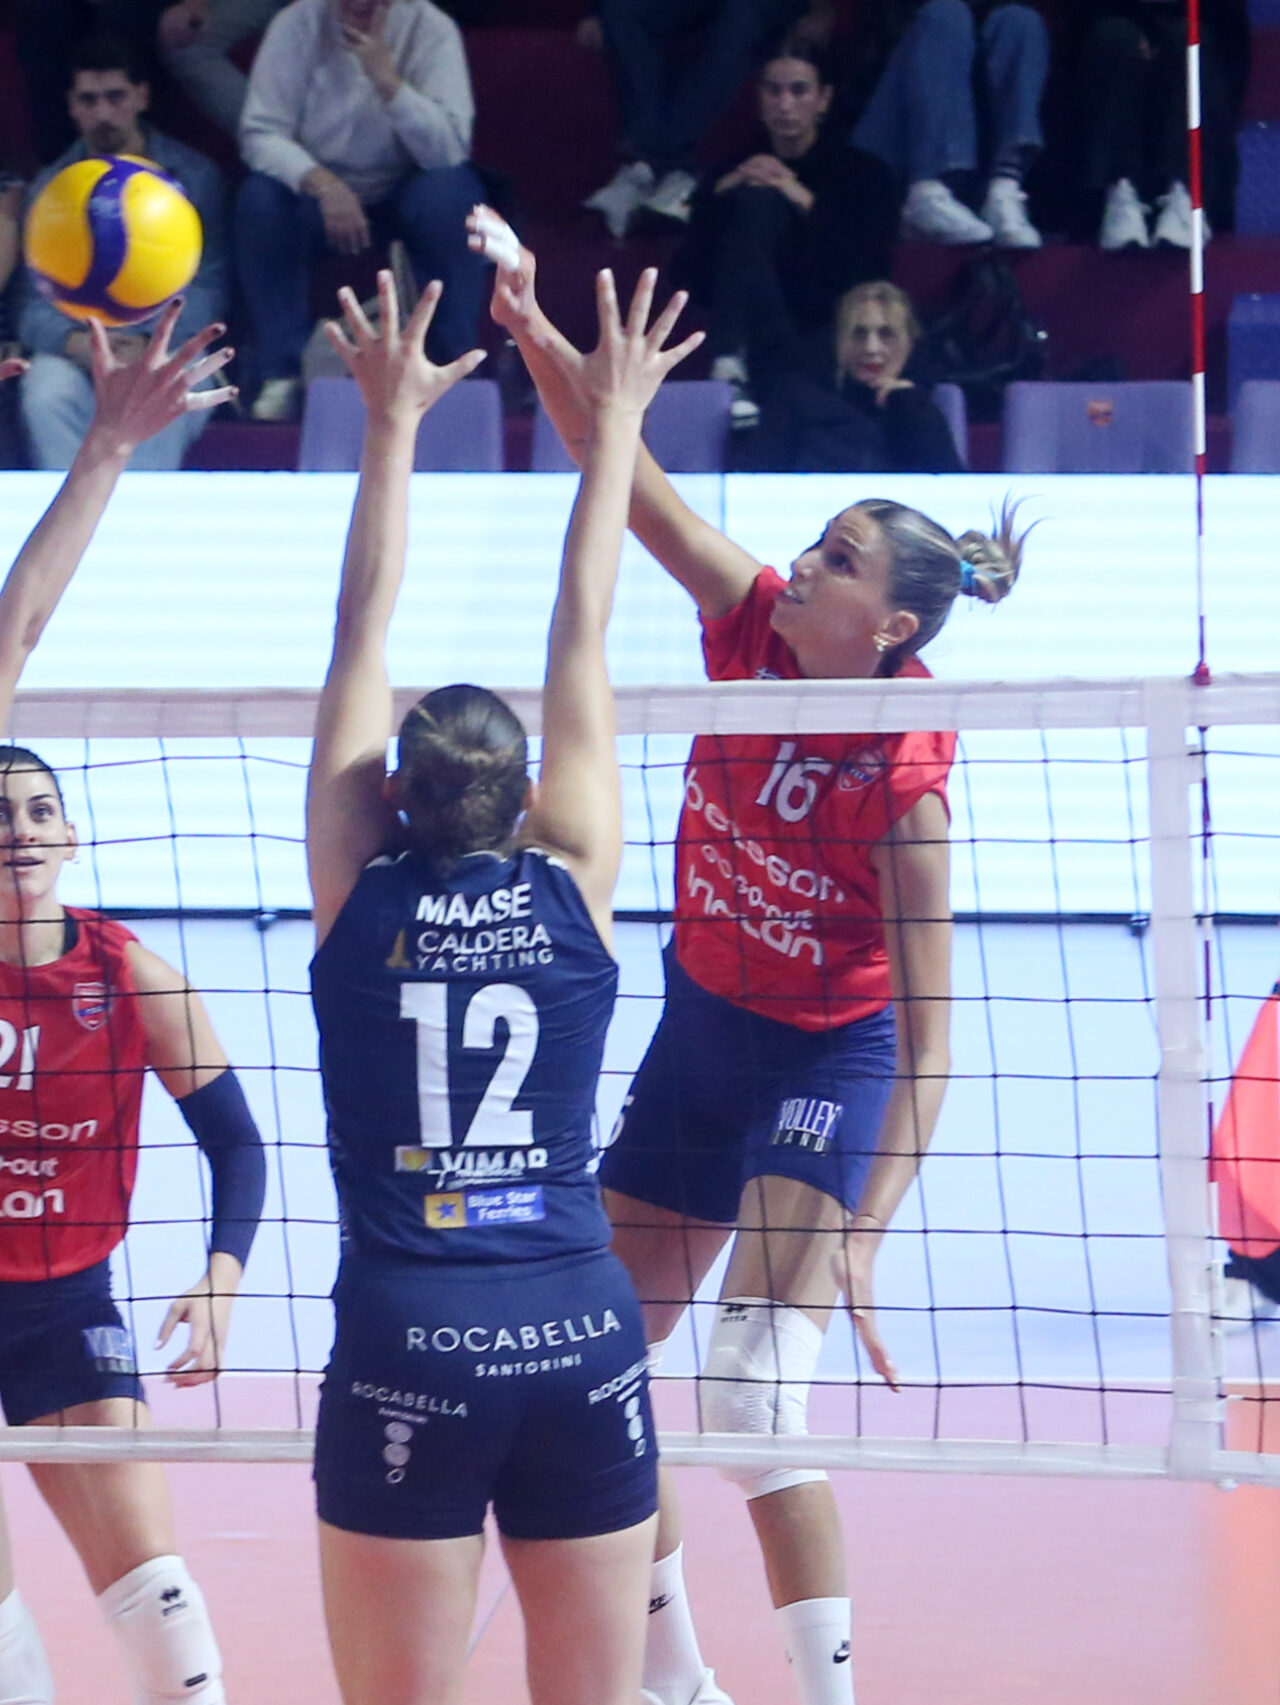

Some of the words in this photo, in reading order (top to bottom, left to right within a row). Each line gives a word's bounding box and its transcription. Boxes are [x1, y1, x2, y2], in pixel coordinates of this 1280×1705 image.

[755, 741, 833, 823] 16
[415, 882, 533, 928] MAASE
[416, 922, 553, 955] CALDERA
[415, 947, 555, 973] YACHTING
[399, 981, 540, 1149] 12
[778, 1097, 842, 1138] VOLLEY
[406, 1308, 622, 1353] ROCABELLA
[474, 1353, 583, 1378] SANTORINI
[351, 1380, 468, 1419] ROCABELLA
